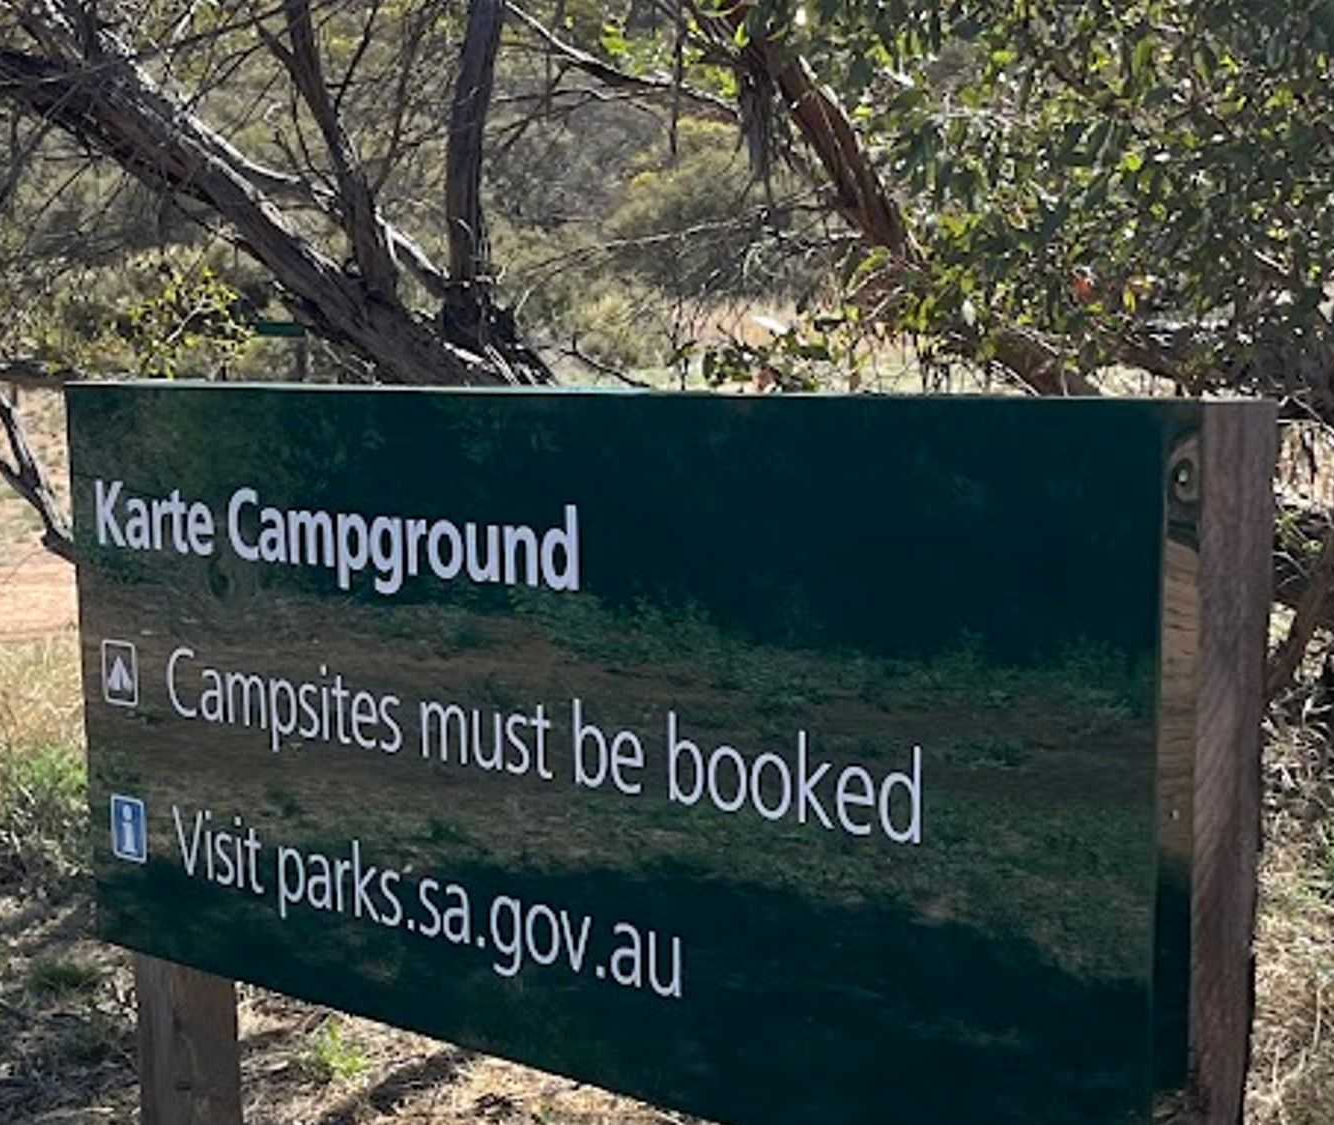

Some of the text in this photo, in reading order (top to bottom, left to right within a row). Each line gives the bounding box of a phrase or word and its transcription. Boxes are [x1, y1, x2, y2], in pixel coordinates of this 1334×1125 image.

[94, 478, 580, 595] Karte Campground
[165, 645, 922, 845] Campsites must be booked
[171, 803, 682, 998] Visit parks.sa.gov.au
